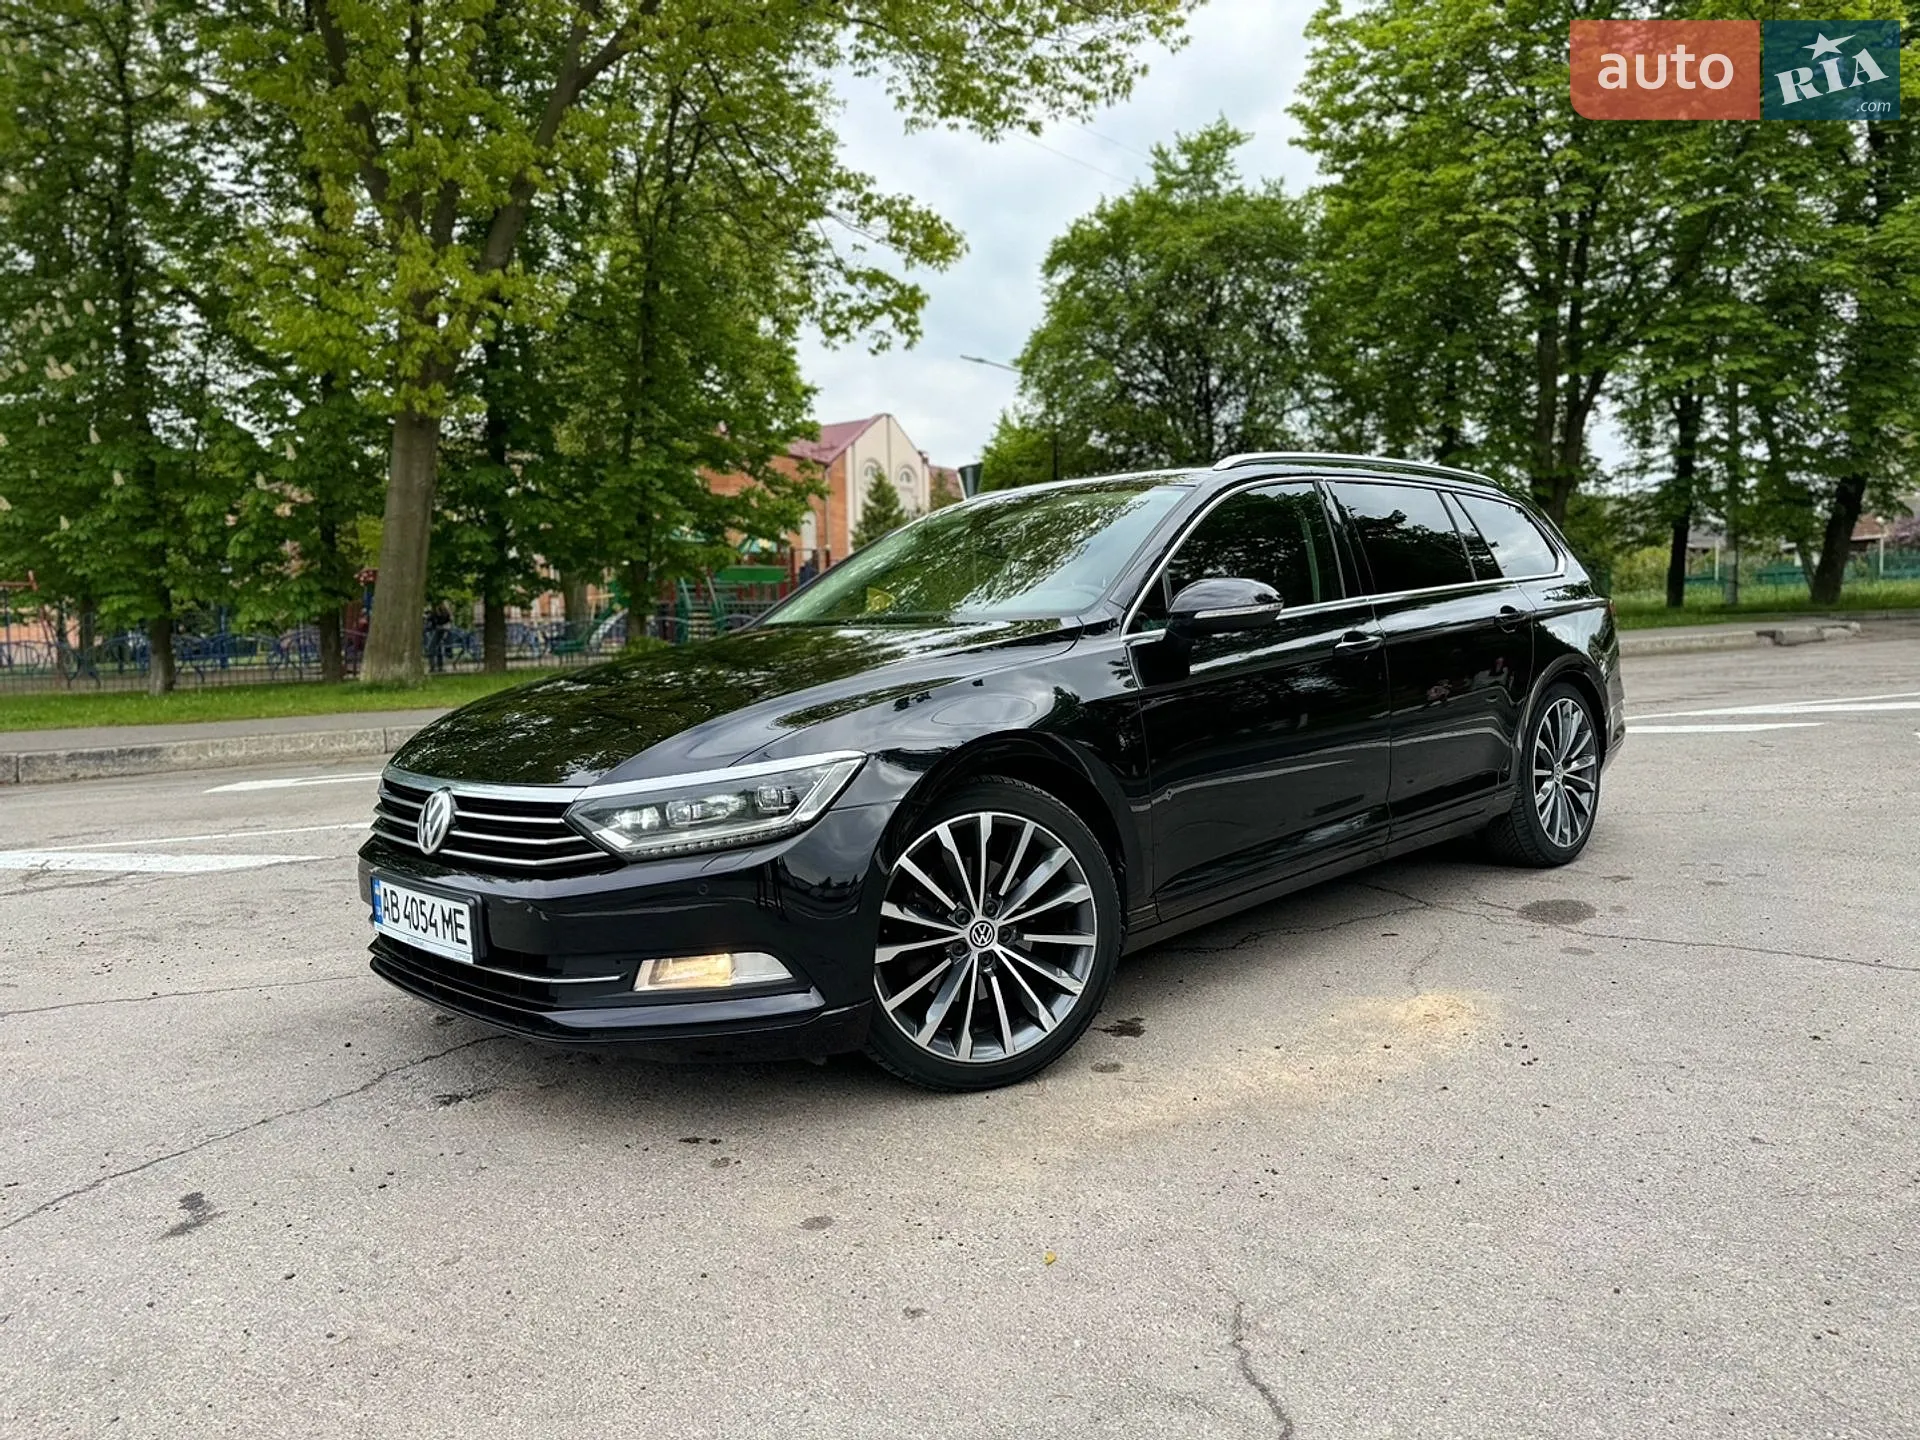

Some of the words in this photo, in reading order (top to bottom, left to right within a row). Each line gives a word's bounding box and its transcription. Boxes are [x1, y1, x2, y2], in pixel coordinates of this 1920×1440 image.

[382, 887, 400, 924] AB
[403, 895, 439, 938] 4054
[440, 904, 468, 946] ME
